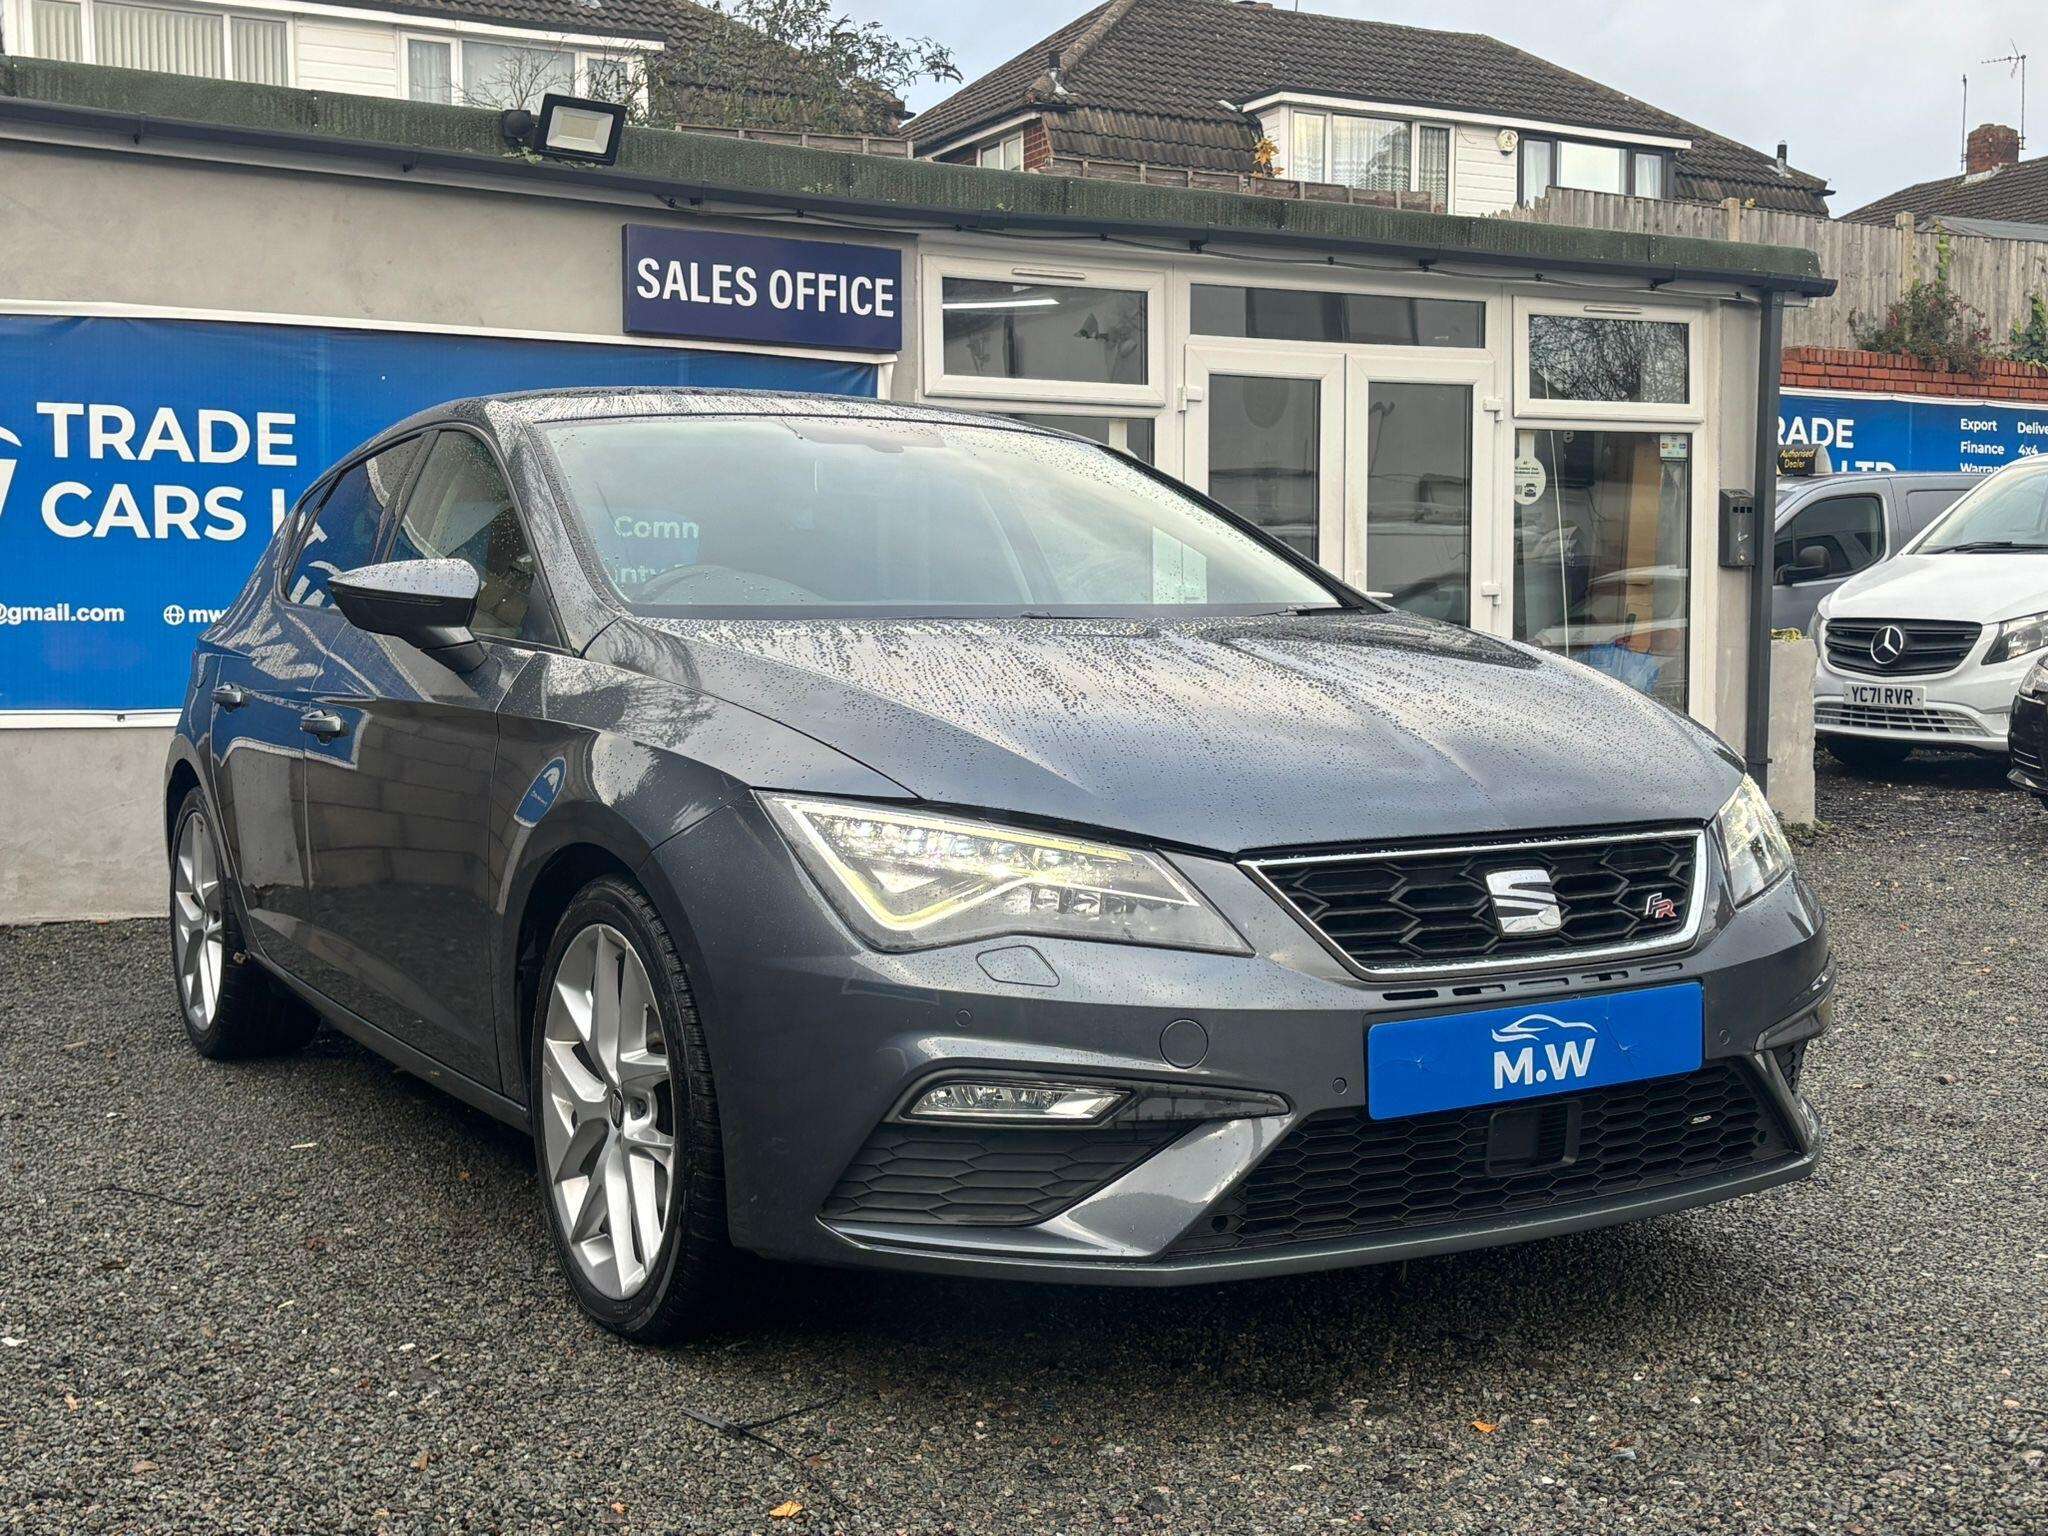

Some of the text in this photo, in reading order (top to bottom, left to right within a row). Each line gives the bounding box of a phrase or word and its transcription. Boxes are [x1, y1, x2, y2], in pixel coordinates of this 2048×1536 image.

[636, 257, 894, 317] SALES OFFICE
[36, 401, 297, 466] TRADE
[1960, 418, 1998, 433] Export
[1960, 441, 2005, 455] Finance
[2017, 444, 2039, 456] 4x4
[1784, 459, 1806, 469] Dealer
[41, 481, 247, 541] CARS
[1851, 686, 1914, 706] YC71 RVR
[1493, 1037, 1597, 1090] M.W
